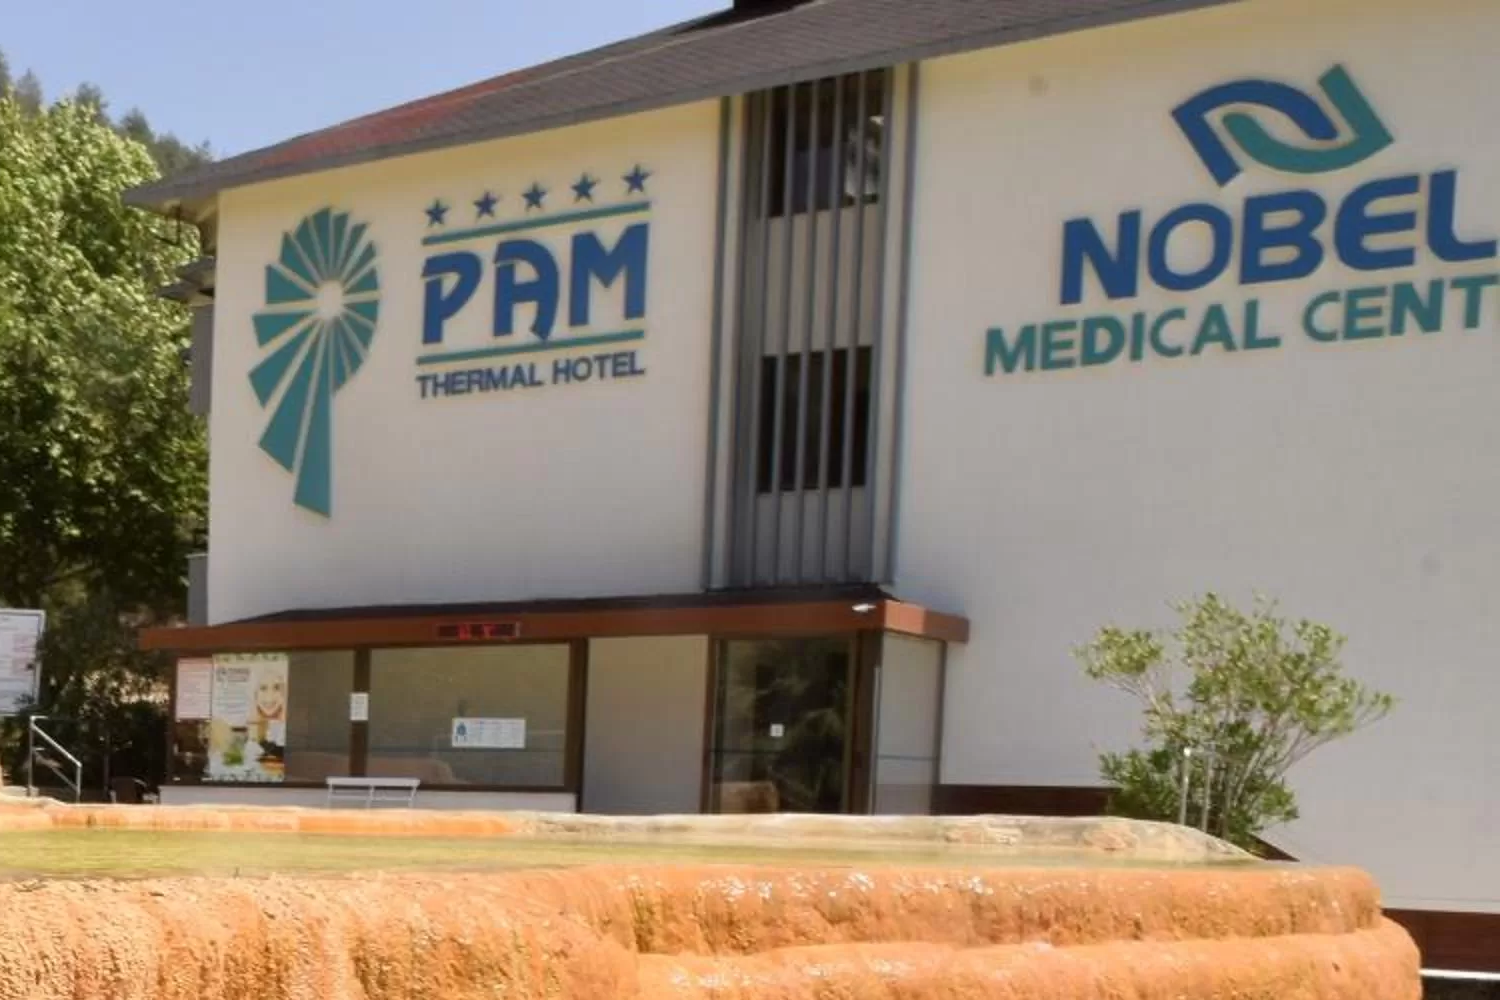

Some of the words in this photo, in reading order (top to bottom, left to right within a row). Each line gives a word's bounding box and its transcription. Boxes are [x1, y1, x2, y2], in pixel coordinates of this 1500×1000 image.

[421, 223, 650, 343] PAM
[1058, 169, 1498, 305] NOBEL
[415, 362, 544, 399] THERMAL
[552, 350, 646, 385] HOTEL
[983, 299, 1281, 377] MEDICAL
[1303, 273, 1500, 342] CENT
